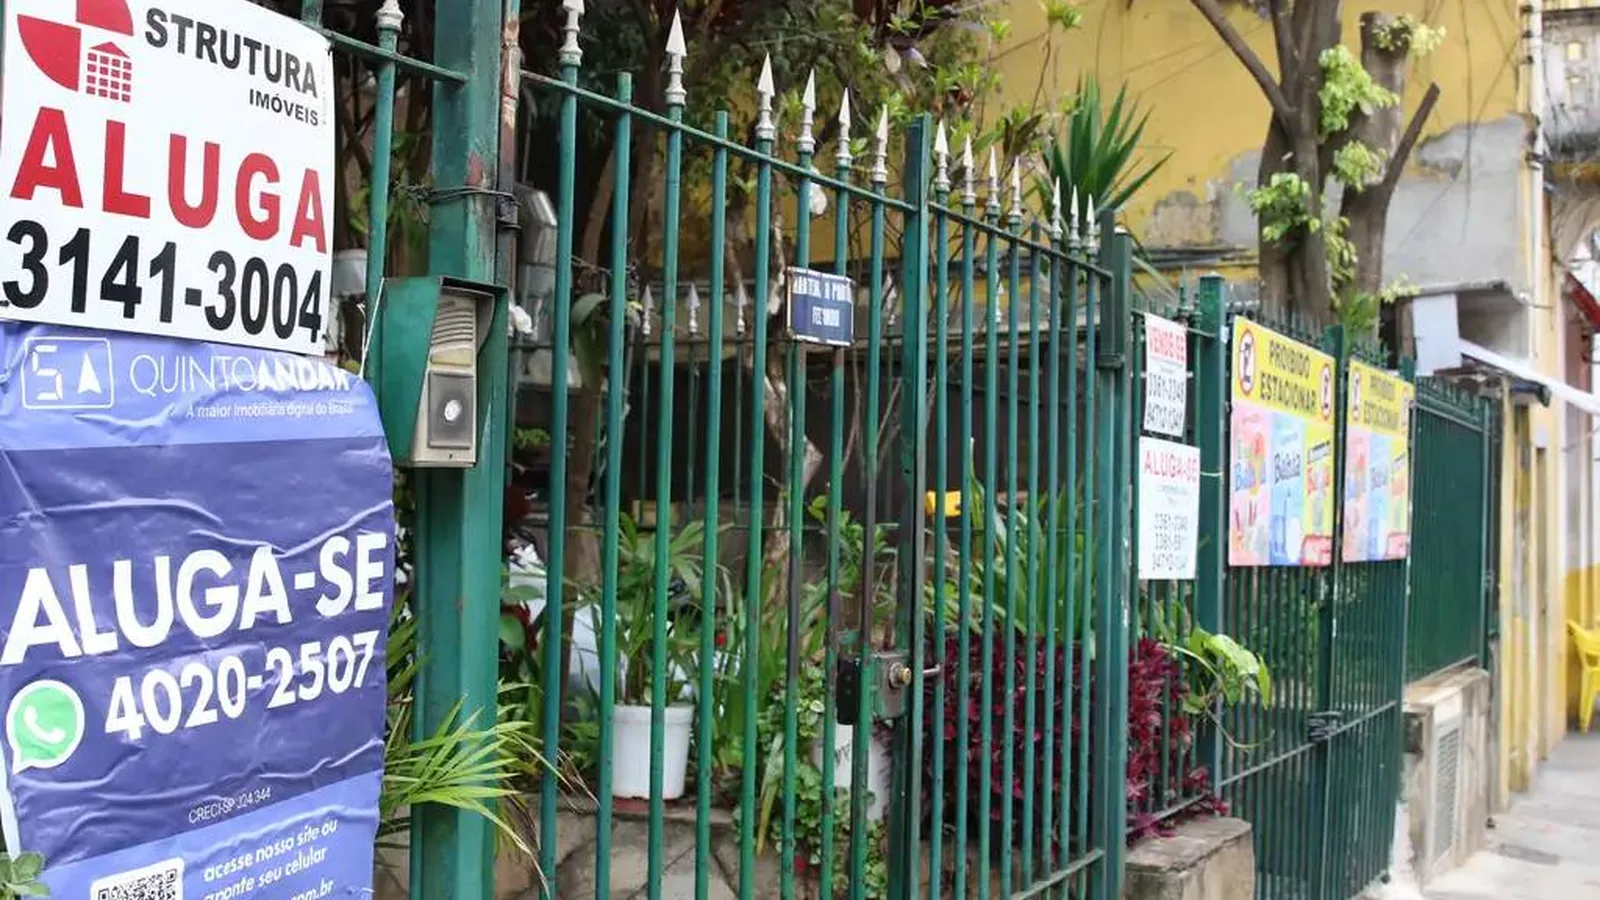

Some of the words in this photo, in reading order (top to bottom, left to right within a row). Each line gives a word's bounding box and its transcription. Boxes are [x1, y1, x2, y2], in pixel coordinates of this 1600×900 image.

[145, 8, 318, 98] STRUTURA
[249, 88, 319, 126] IMÓVEIS
[10, 106, 327, 254] ALUGA
[2, 220, 322, 343] 3141-3004
[1260, 371, 1317, 412] ESTACIONAR
[1269, 340, 1311, 379] PROIBIDO
[0, 532, 387, 662] ALUGA-SE
[104, 629, 380, 741] 4020-2507
[203, 853, 253, 882] acesse
[255, 836, 294, 863] nosso
[296, 824, 321, 847] site
[321, 819, 339, 836] ou
[257, 867, 283, 888] seu
[284, 846, 328, 876] celular
